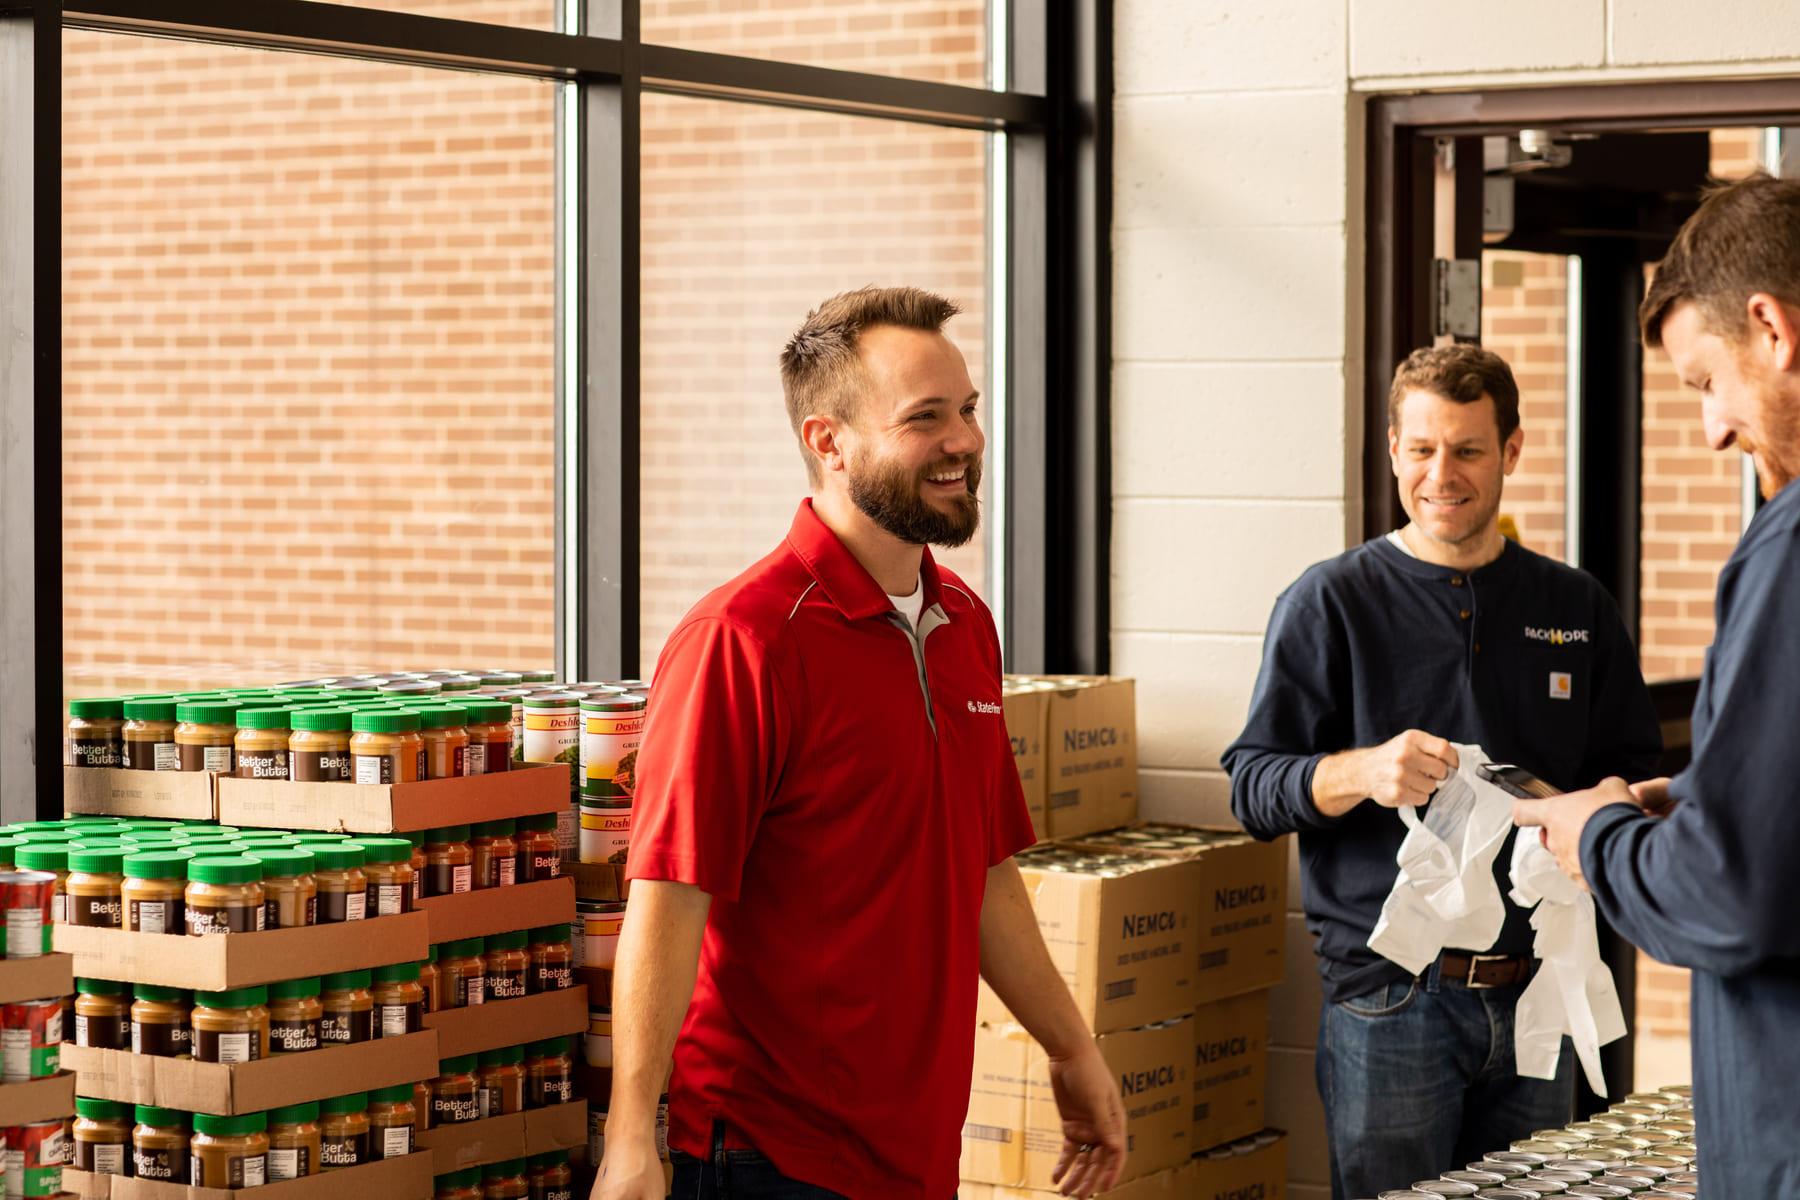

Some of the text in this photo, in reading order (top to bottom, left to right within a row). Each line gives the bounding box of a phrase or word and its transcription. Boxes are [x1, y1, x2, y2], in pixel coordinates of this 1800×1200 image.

[72, 744, 106, 755] Better
[87, 755, 120, 764] Butta
[239, 756, 273, 767] Better
[320, 757, 351, 768] Bett
[253, 766, 288, 777] Butta
[90, 902, 121, 913] Bett
[485, 976, 514, 988] etter
[495, 986, 525, 997] Butta
[270, 1026, 305, 1039] etter
[321, 1029, 350, 1040] utta
[284, 1036, 317, 1049] Butta
[435, 1100, 472, 1111] Better
[321, 1152, 357, 1164] Butta
[138, 1163, 171, 1176] Butta
